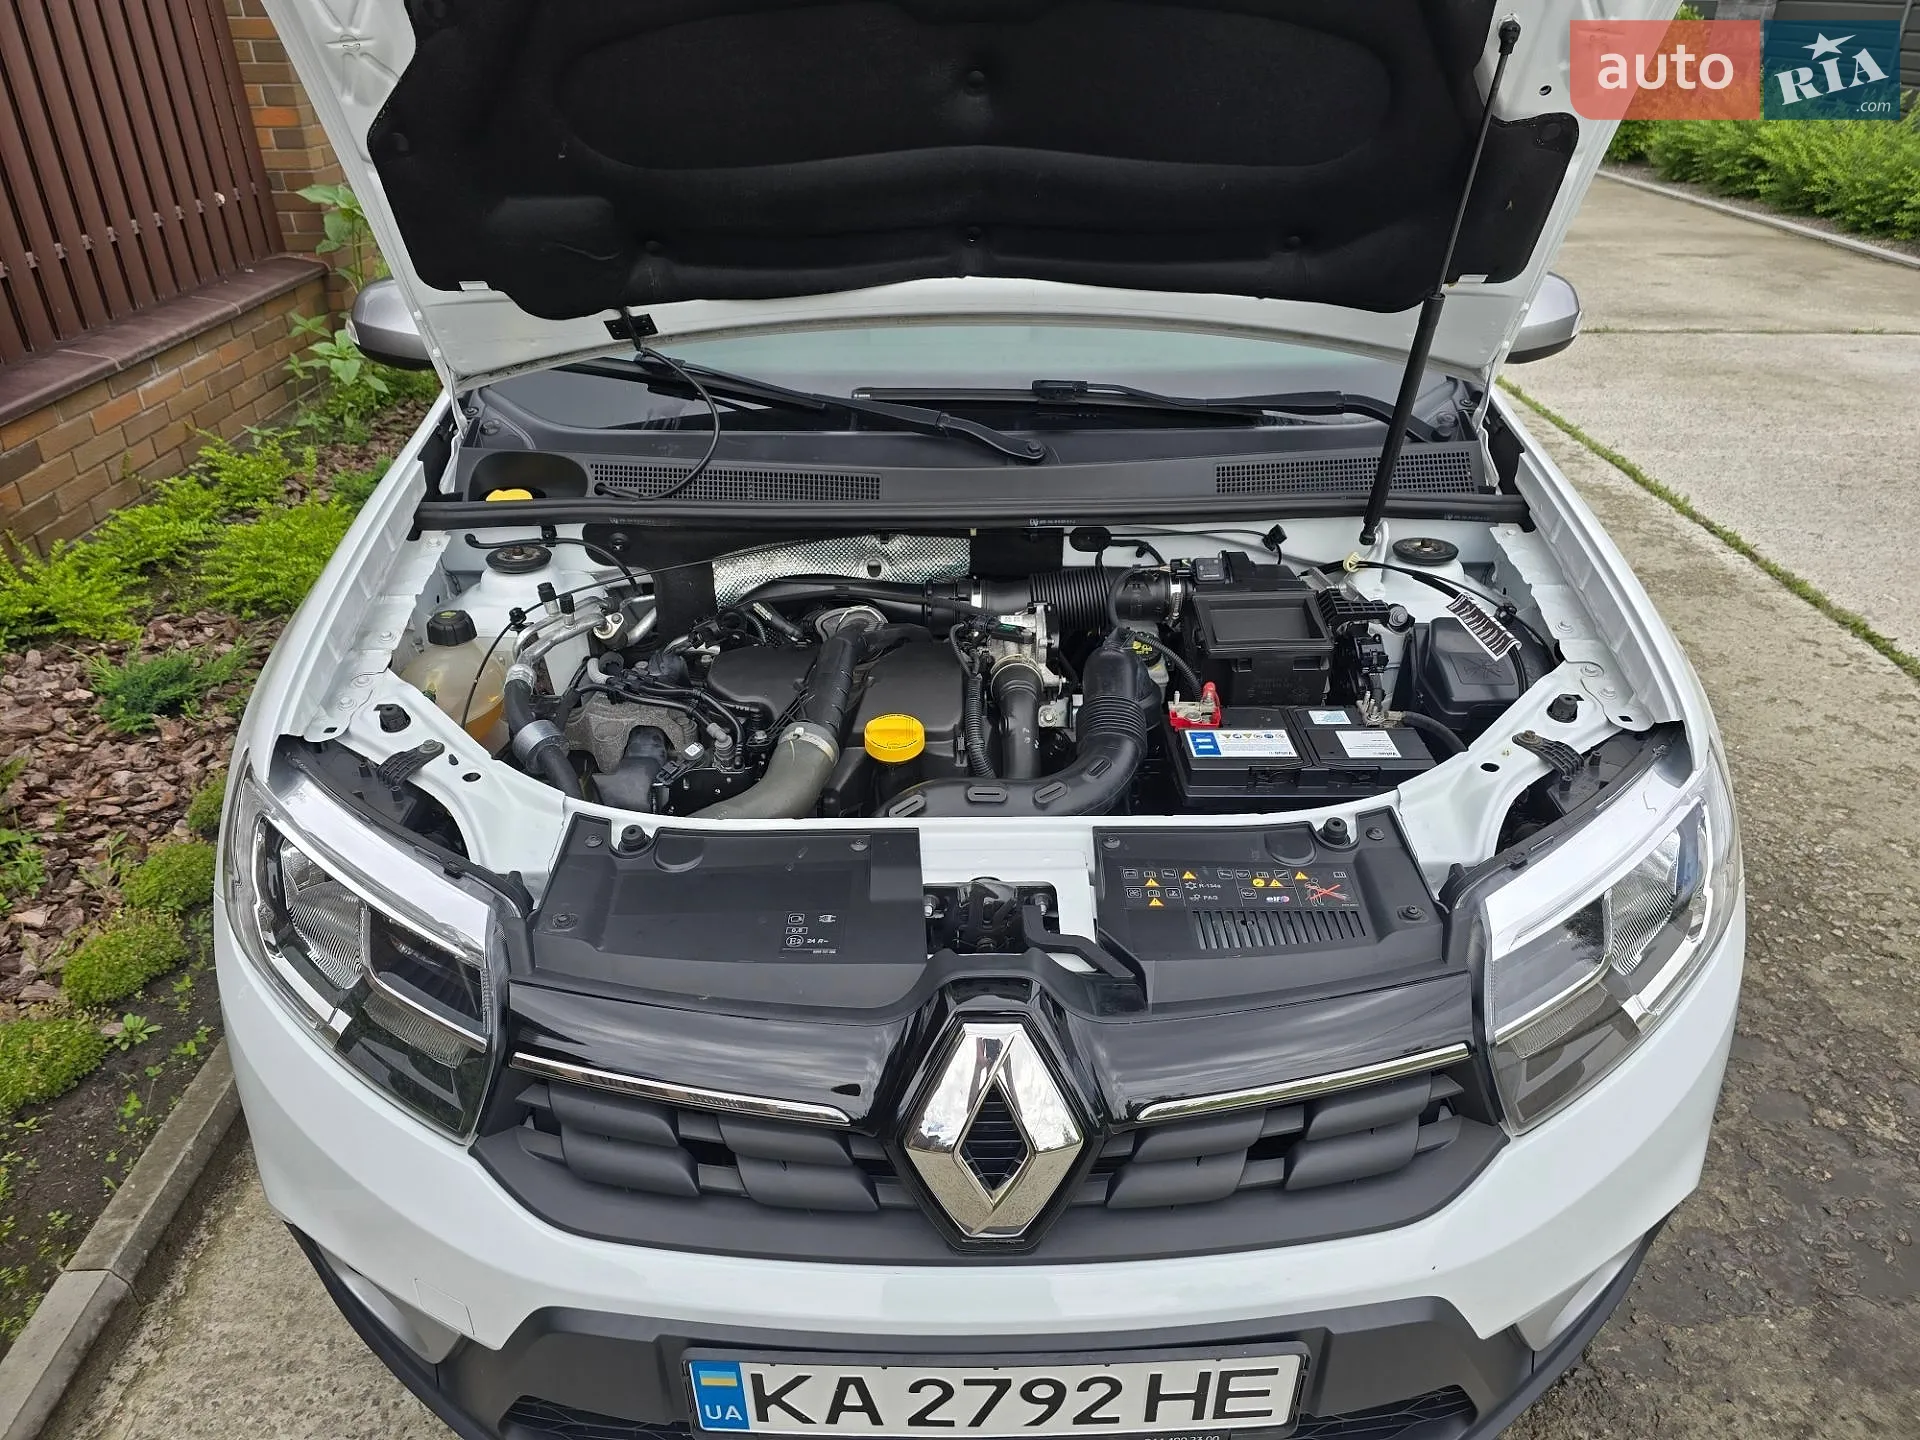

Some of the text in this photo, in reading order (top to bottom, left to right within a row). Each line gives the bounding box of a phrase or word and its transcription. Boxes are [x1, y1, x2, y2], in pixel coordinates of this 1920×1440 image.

[704, 1404, 744, 1421] UA
[750, 1367, 1280, 1428] KA 2792 HE
